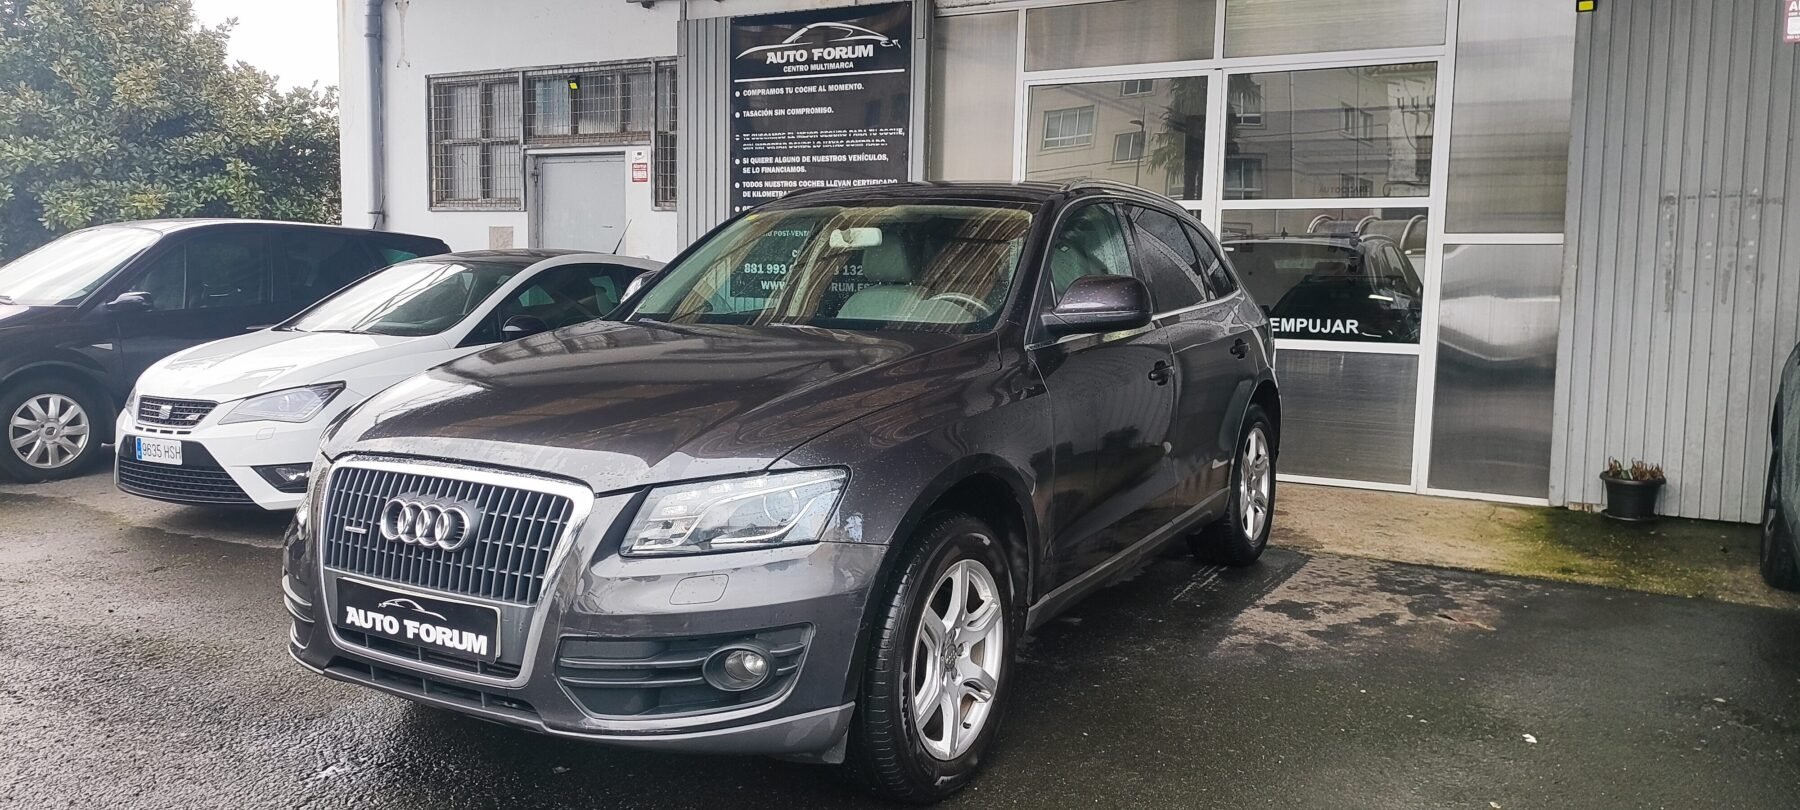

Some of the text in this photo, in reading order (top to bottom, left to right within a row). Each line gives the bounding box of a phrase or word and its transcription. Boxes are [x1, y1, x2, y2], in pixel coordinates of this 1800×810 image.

[766, 44, 874, 64] AUTO FORUM
[783, 61, 854, 73] CENTRO MULTIMARCA
[743, 87, 784, 97] COMPRAMOS
[785, 87, 794, 95] TU
[795, 85, 817, 94] COCHE
[828, 83, 865, 91] MOMENTO.
[743, 108, 773, 117] TASACIÓN
[786, 106, 834, 115] COMPROMISO.
[742, 152, 889, 164] SI QUIERE ALGUNO DE NUESTROS VEHÍCULOS,
[742, 165, 807, 174] SE LO FINANCIAMOS.
[764, 180, 797, 188] NUESTROS
[798, 179, 824, 188] COCHES
[825, 179, 851, 188] LLEVAN
[742, 190, 751, 198] DE
[744, 263, 764, 274] 881
[766, 263, 787, 275] 993
[1270, 317, 1360, 335] EMPUJAR
[142, 442, 182, 460] 9635 HSH
[346, 606, 488, 656] AUTO FORUM
